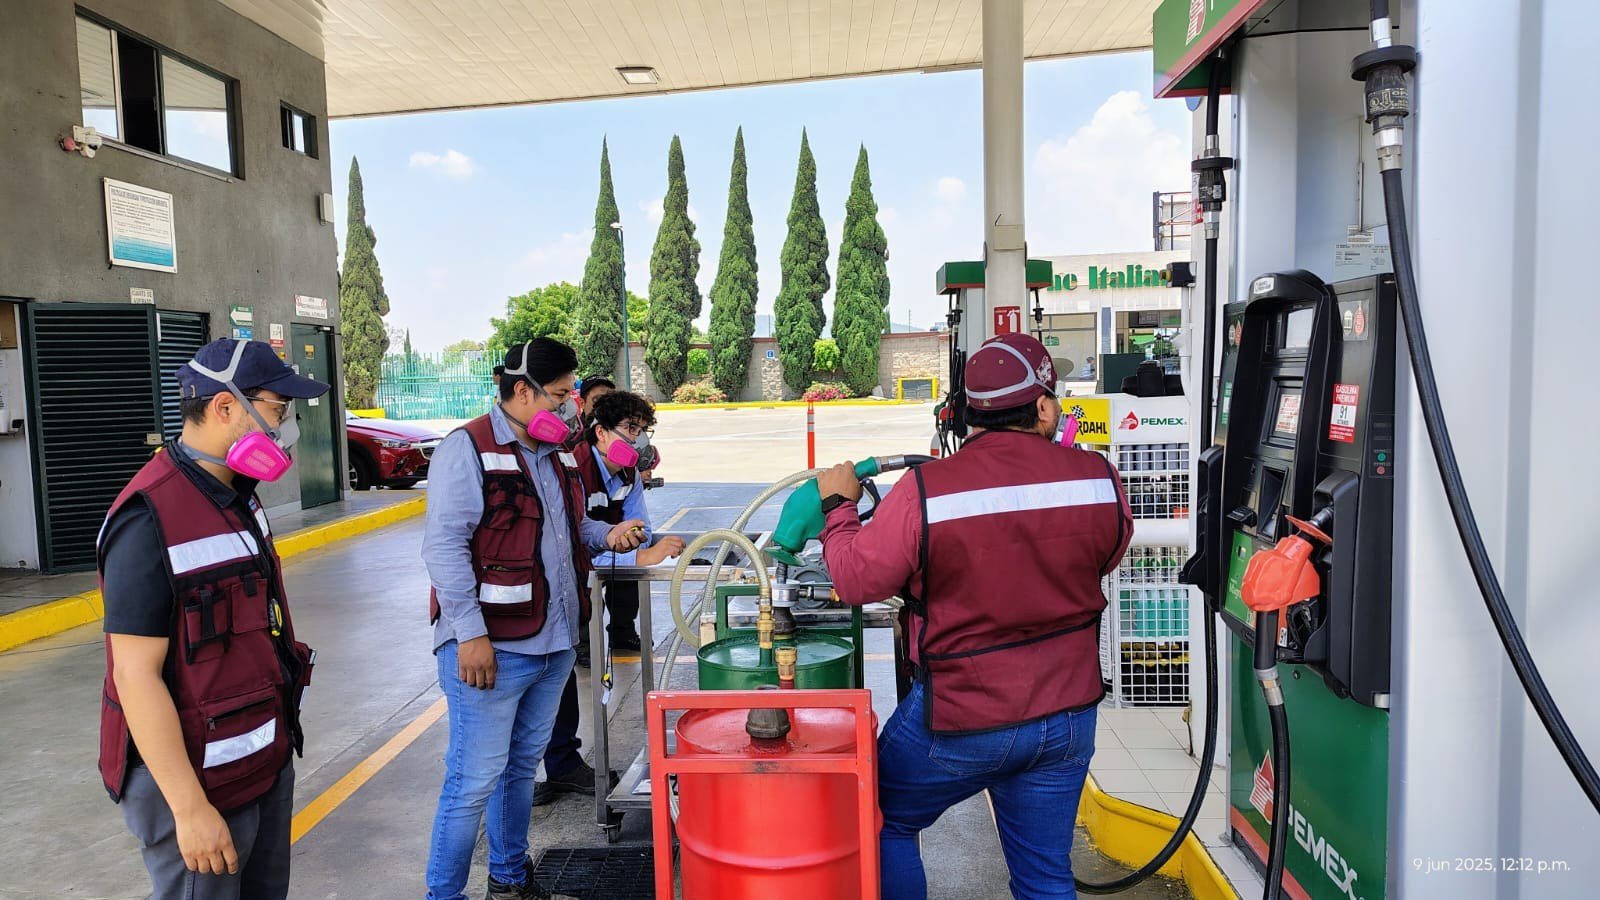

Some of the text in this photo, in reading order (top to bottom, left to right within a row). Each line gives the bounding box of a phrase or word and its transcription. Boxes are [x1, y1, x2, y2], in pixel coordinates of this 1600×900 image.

[1047, 273, 1078, 292] he
[1335, 385, 1357, 394] GASOLINA
[1339, 405, 1348, 419] 91
[1077, 420, 1108, 436] RDAHL
[1141, 417, 1184, 426] PEMEX
